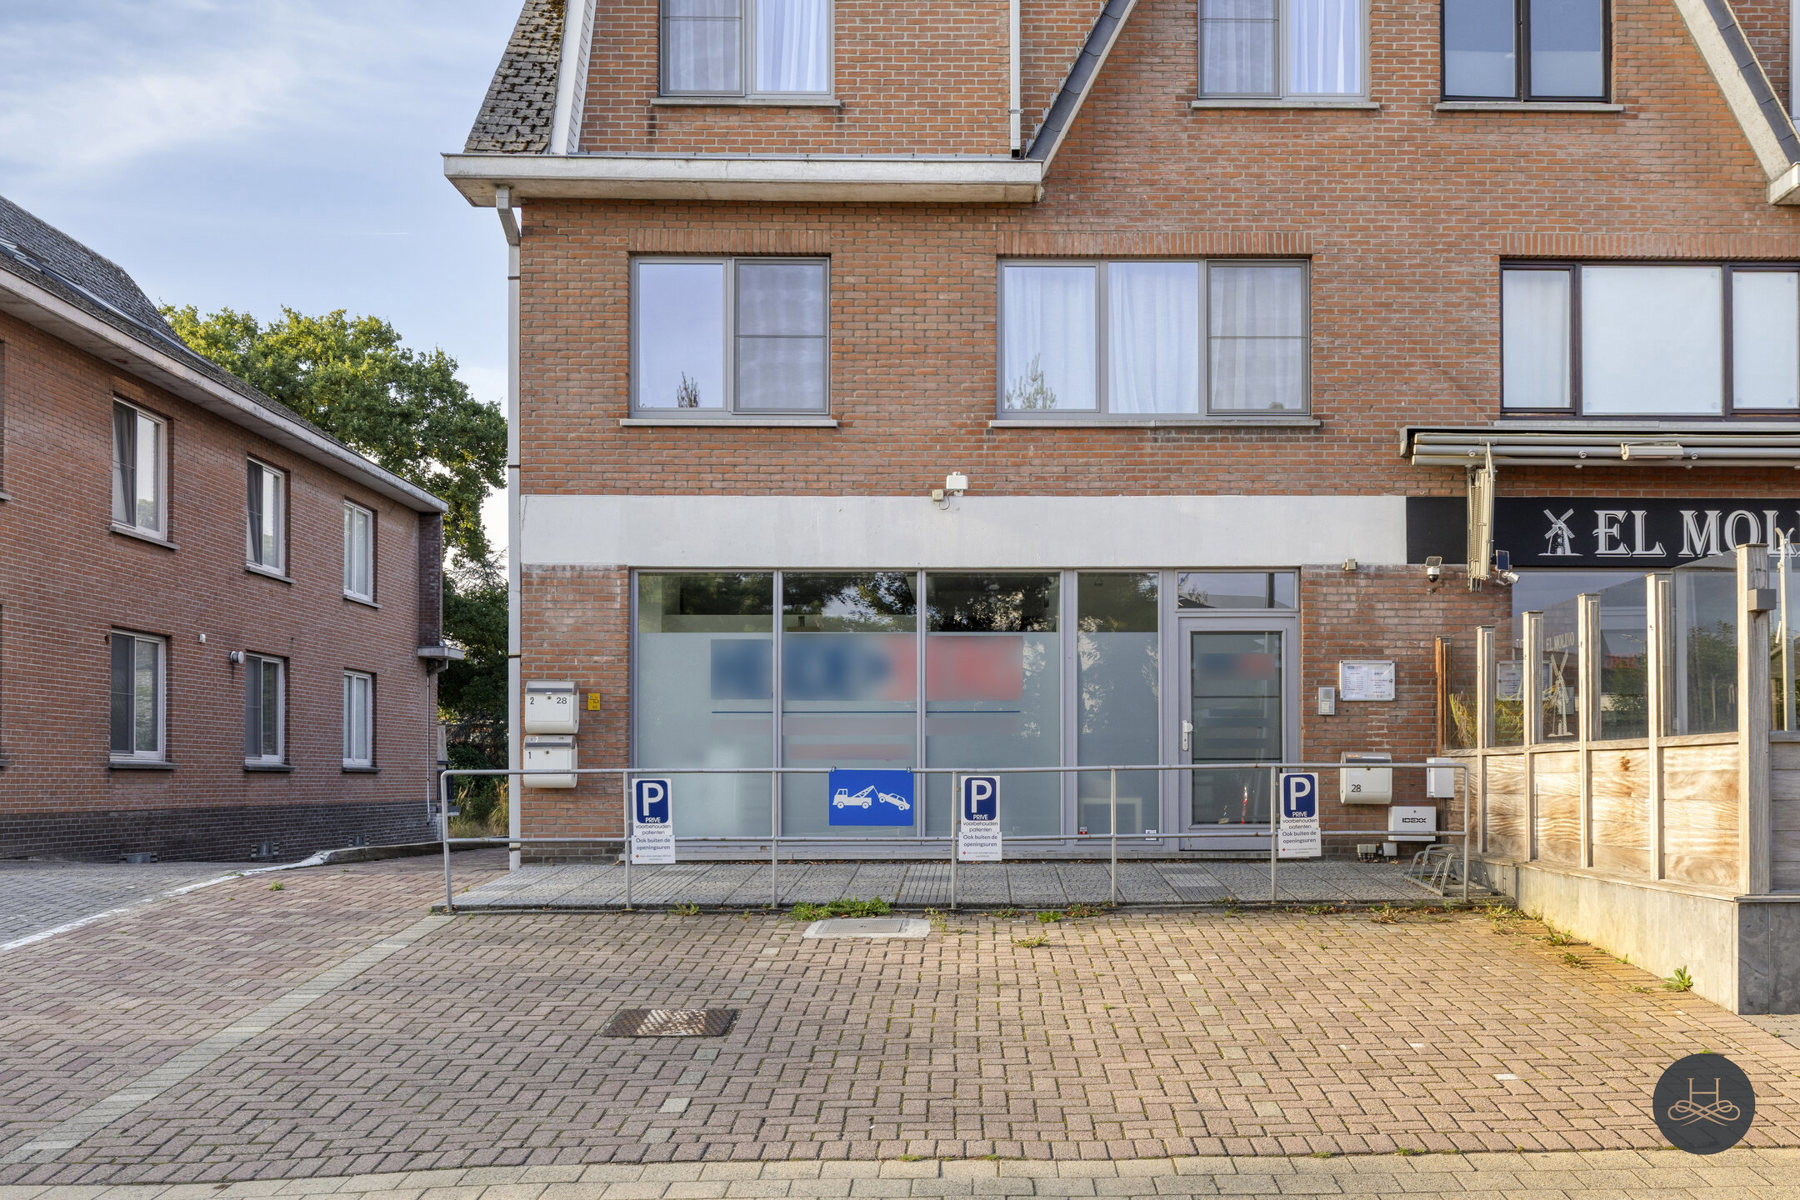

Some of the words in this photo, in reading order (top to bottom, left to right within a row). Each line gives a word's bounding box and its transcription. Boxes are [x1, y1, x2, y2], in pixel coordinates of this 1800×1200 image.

[1593, 510, 1667, 557] EL
[1678, 510, 1800, 557] MOL
[530, 697, 535, 705] 2
[642, 782, 664, 816] P
[971, 780, 992, 813] P
[1290, 777, 1311, 810] P
[1351, 784, 1361, 793] 28
